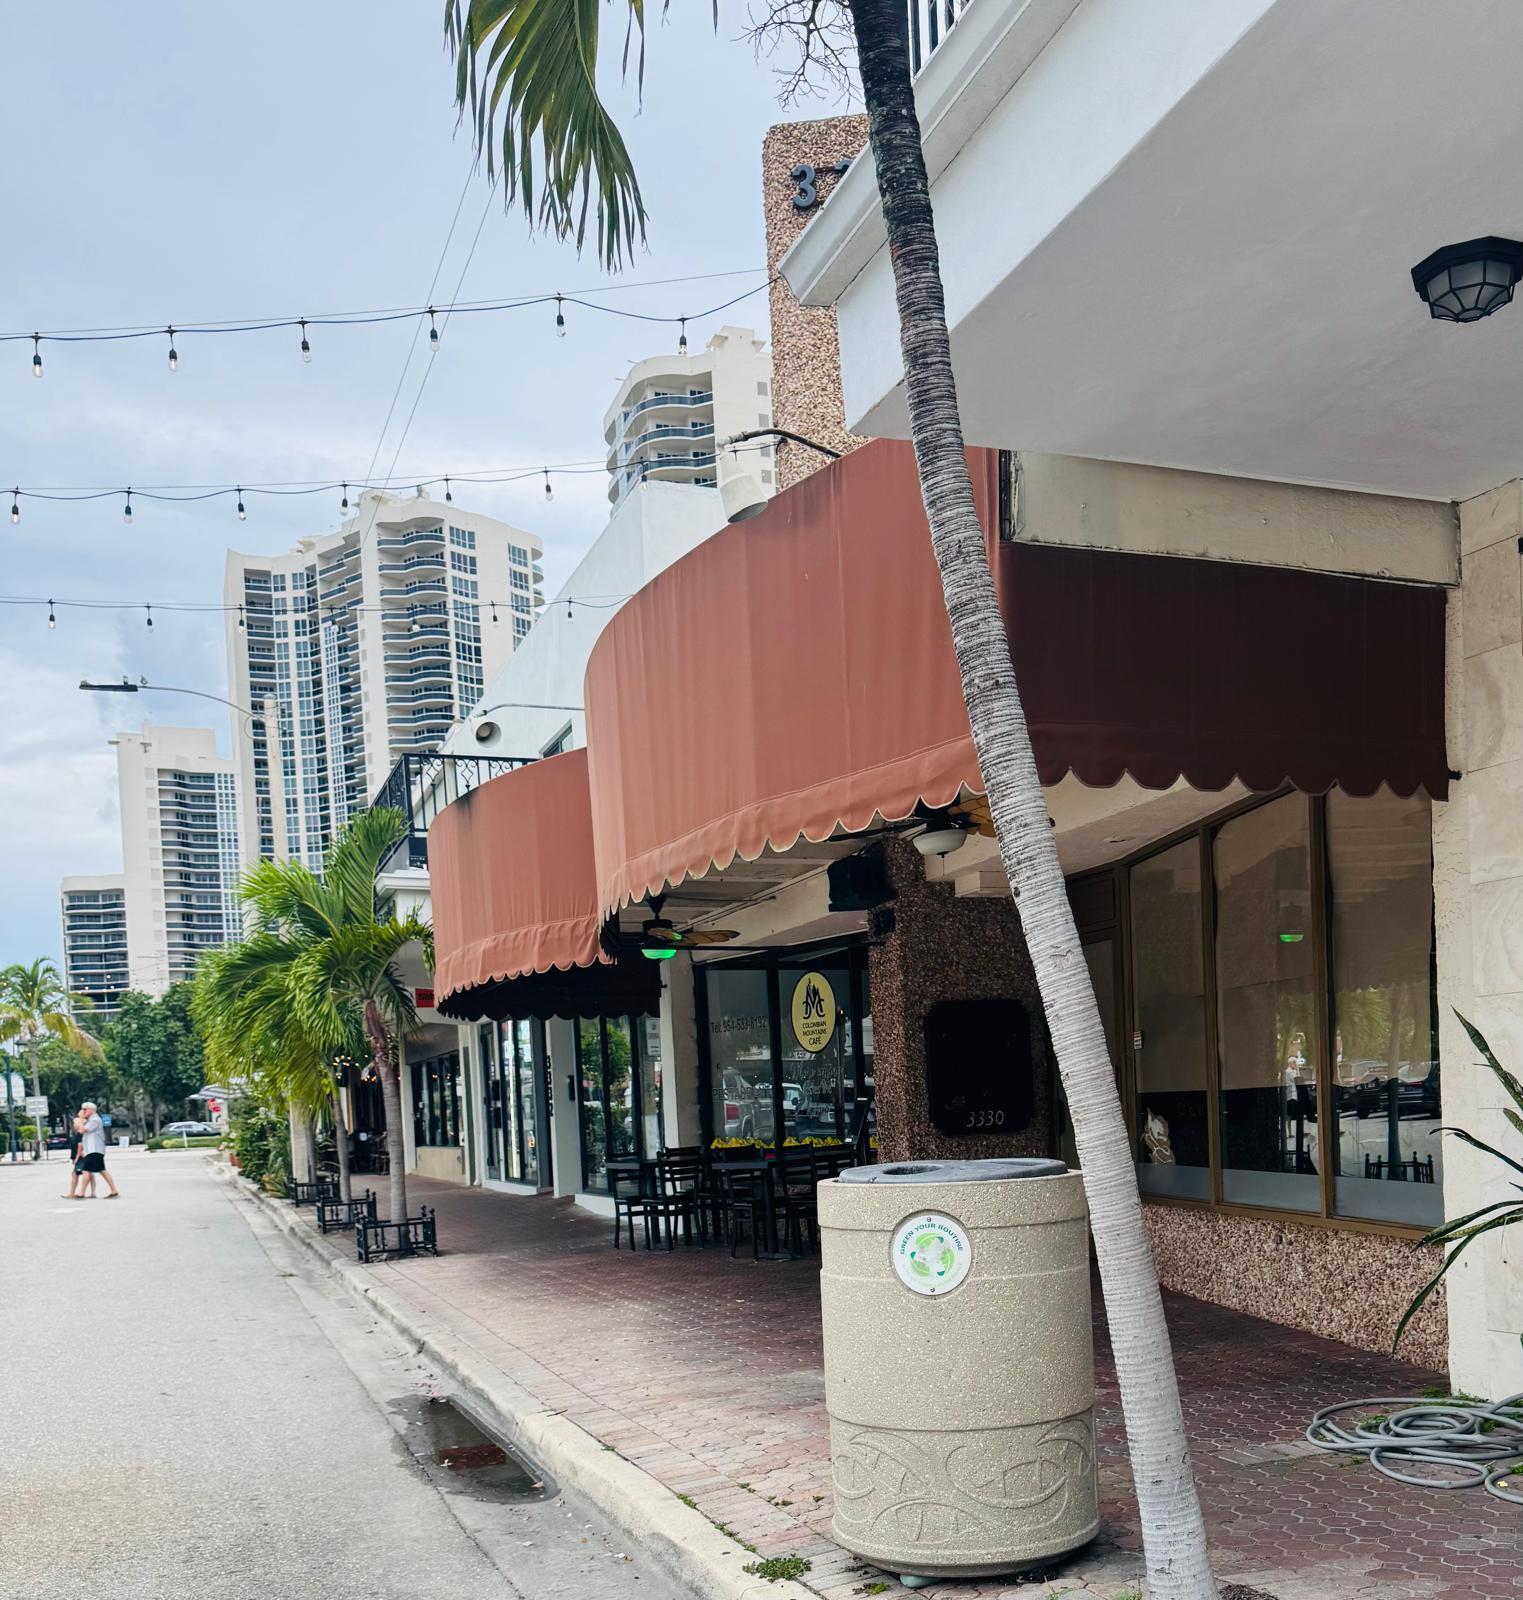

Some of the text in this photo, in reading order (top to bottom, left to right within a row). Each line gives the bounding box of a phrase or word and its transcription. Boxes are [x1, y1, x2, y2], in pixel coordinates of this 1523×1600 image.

[803, 1021, 826, 1029] COLOMBIAN
[803, 1029, 827, 1037] MOUNTAINS
[808, 1035, 822, 1045] CAFÉ
[966, 1110, 1005, 1127] 3330
[901, 1223, 963, 1254] GREEN YOUR ROUTINE
